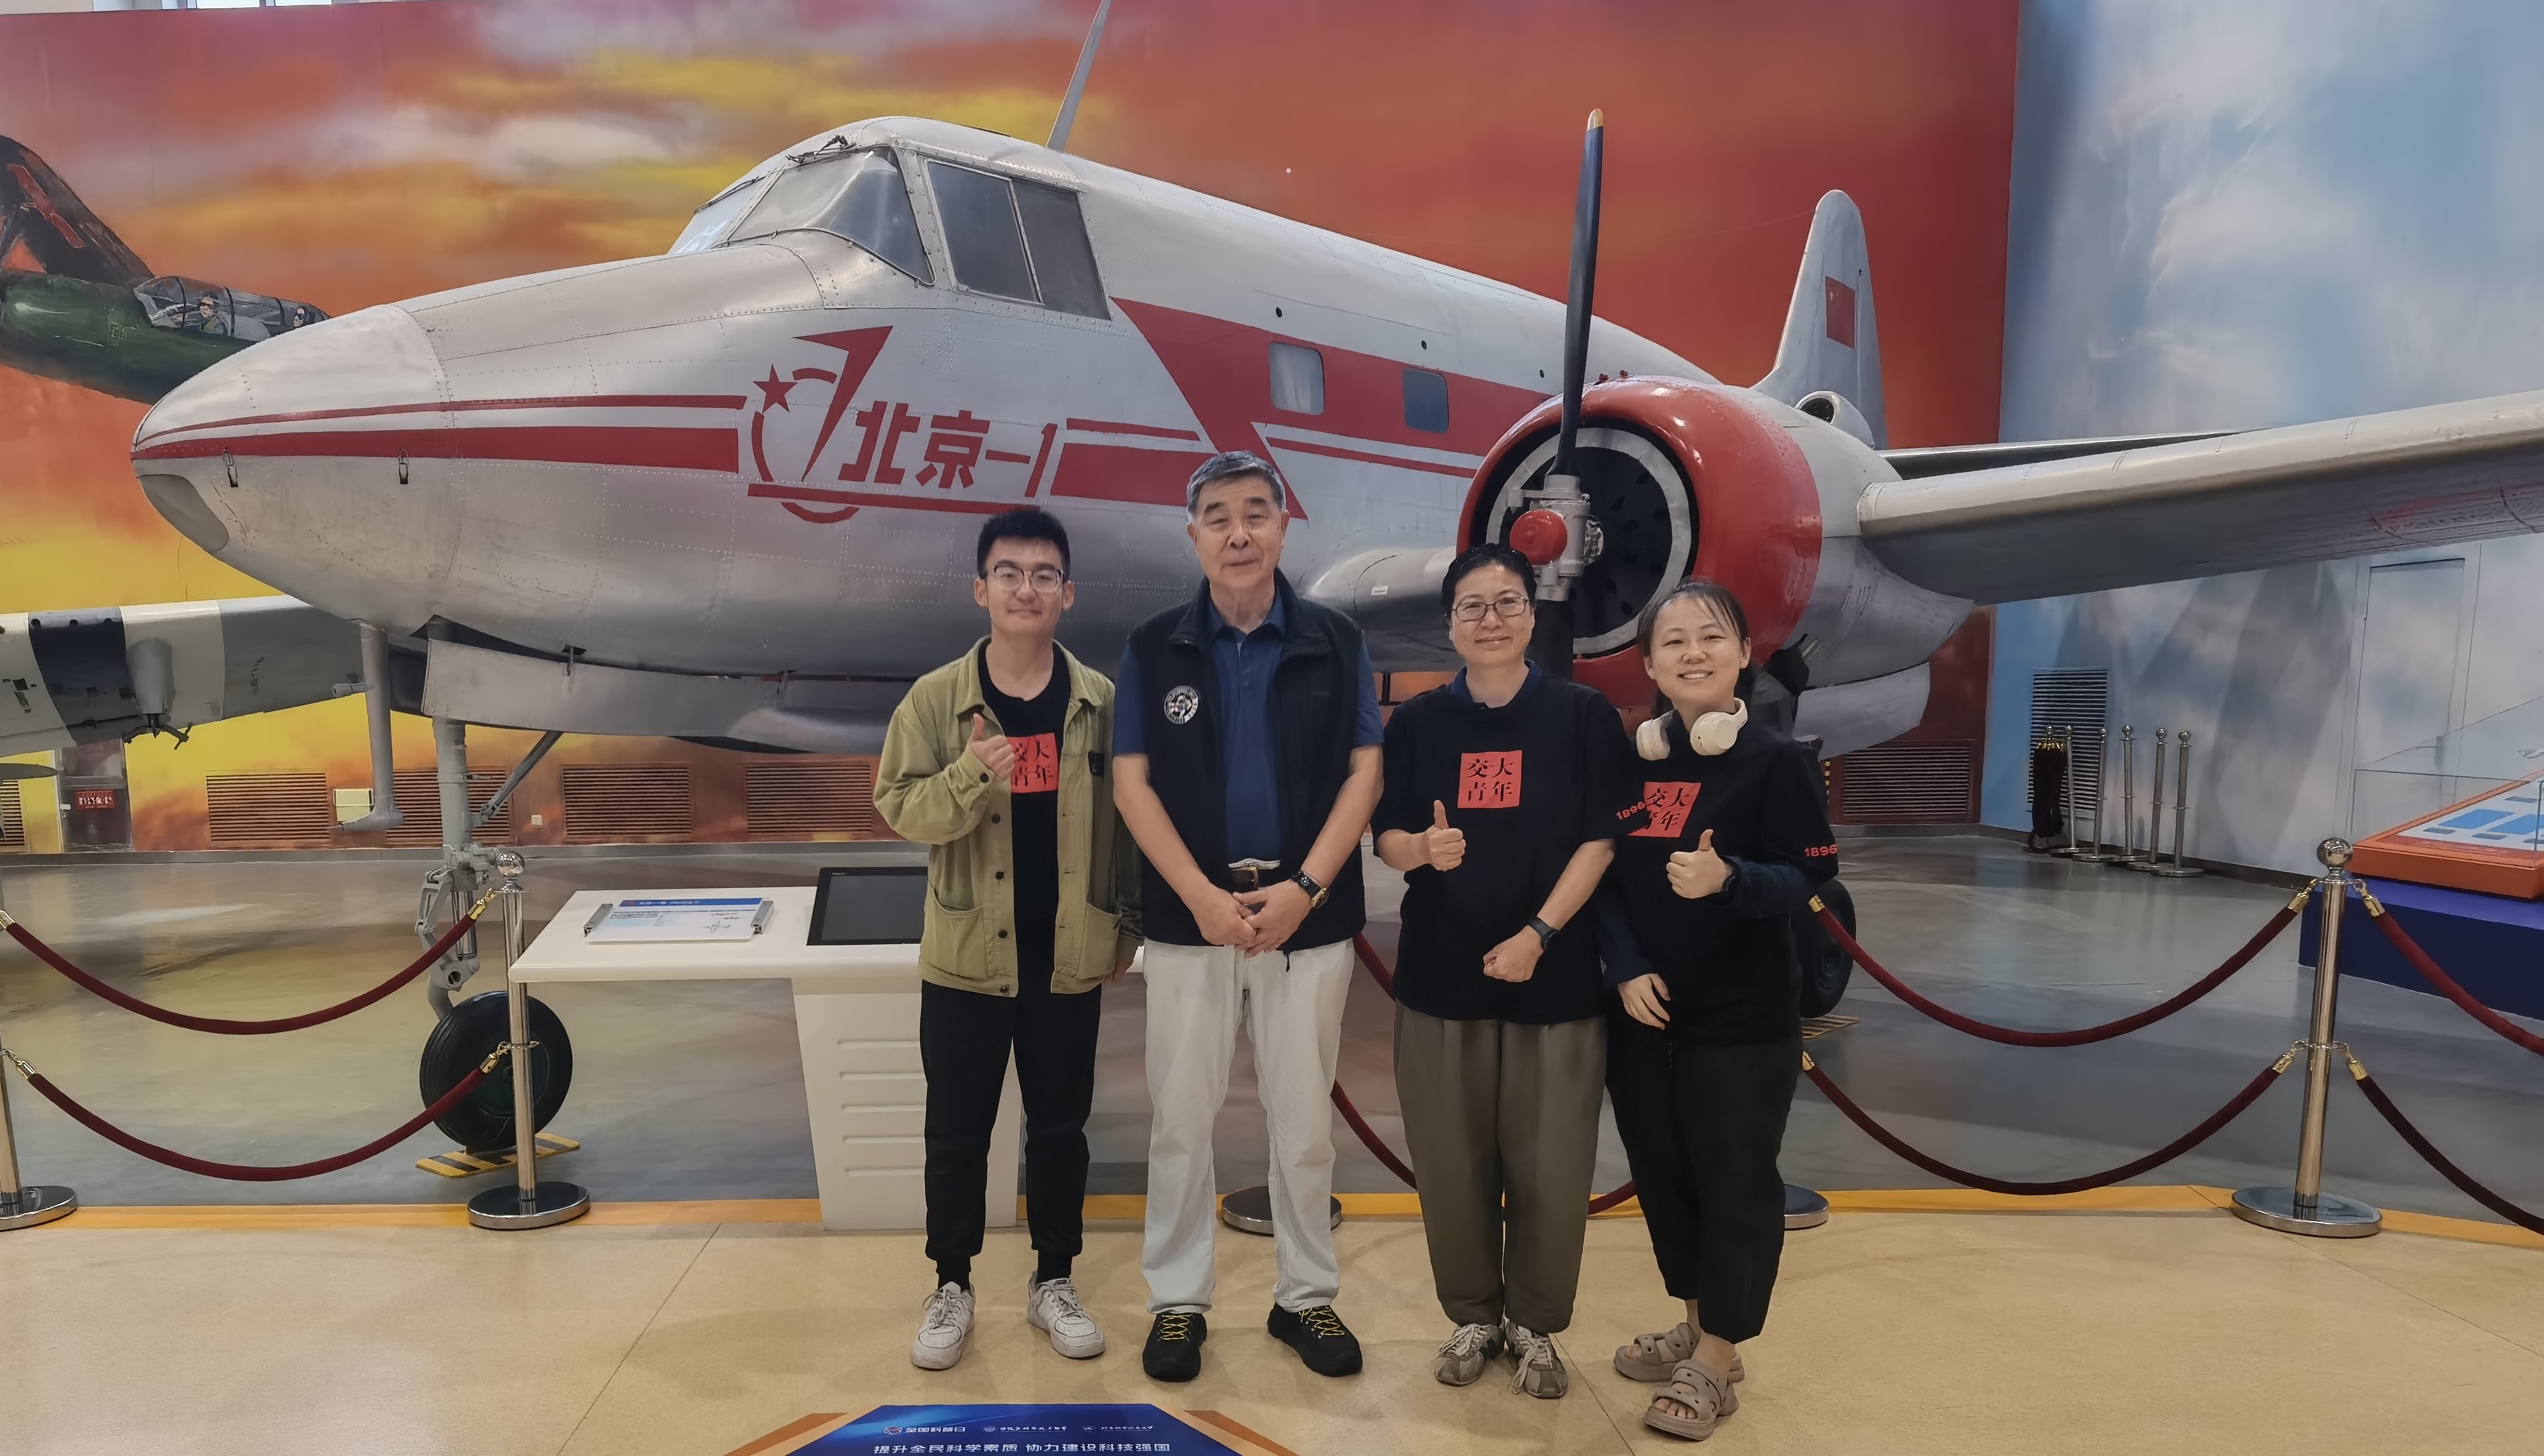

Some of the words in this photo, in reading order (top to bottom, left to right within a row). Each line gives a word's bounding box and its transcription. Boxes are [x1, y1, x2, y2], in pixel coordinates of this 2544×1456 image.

[1466, 757, 1514, 778] 交大
[1468, 781, 1513, 802] 青年
[1645, 787, 1691, 808] 交大
[1616, 801, 1646, 820] 1896
[1804, 843, 1838, 857] 1896
[873, 1443, 1019, 1454] 提升全民科学素质
[1025, 1443, 1171, 1452] 协力建设科技强国
